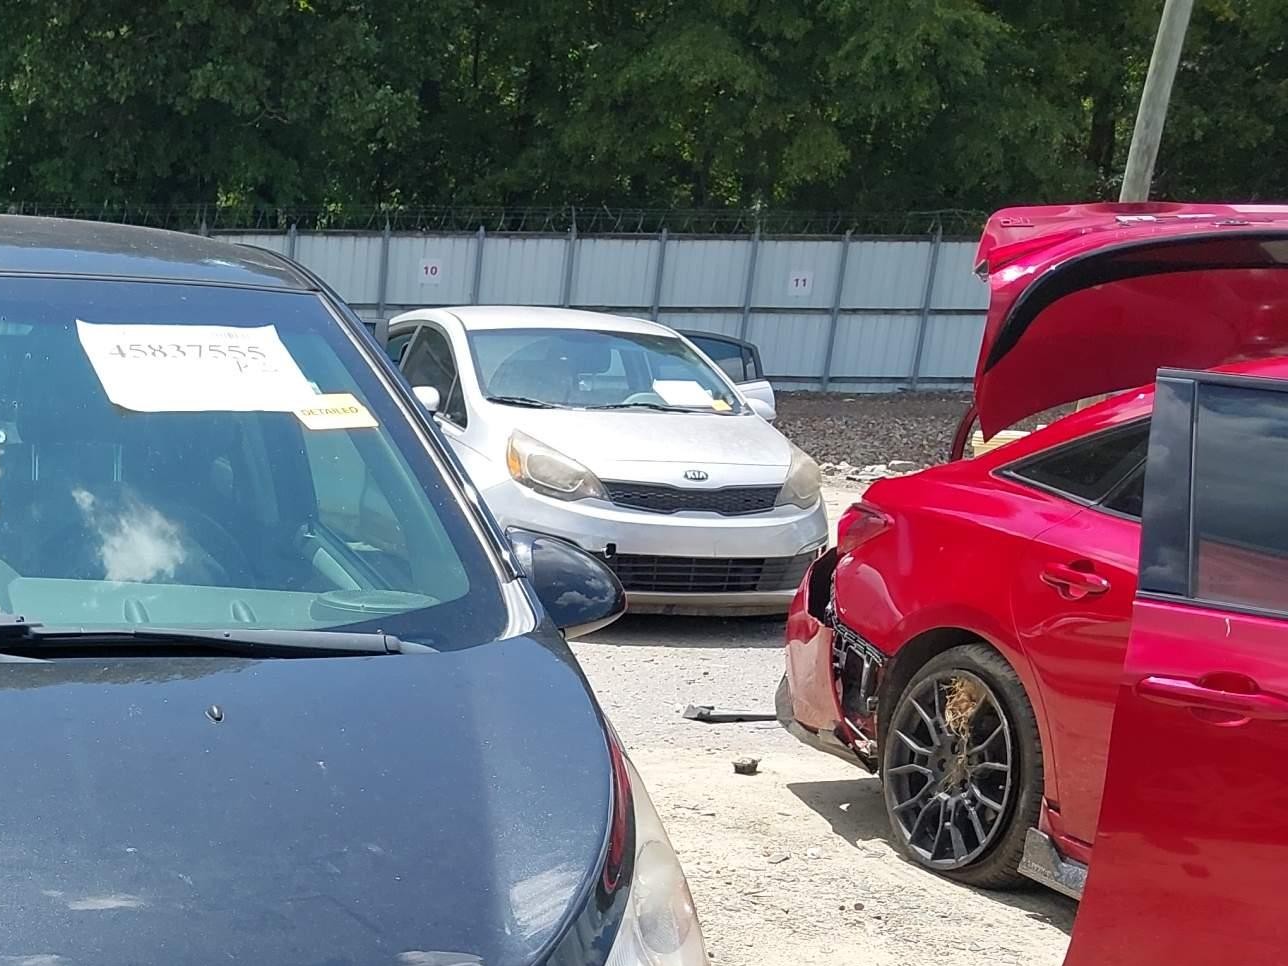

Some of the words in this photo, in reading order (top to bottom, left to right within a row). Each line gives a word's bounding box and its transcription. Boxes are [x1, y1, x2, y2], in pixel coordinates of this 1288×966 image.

[423, 265, 438, 276] 10
[793, 277, 808, 288] 11
[108, 343, 267, 360] 45837555
[300, 406, 359, 416] DETAILED
[684, 470, 708, 481] KIA
